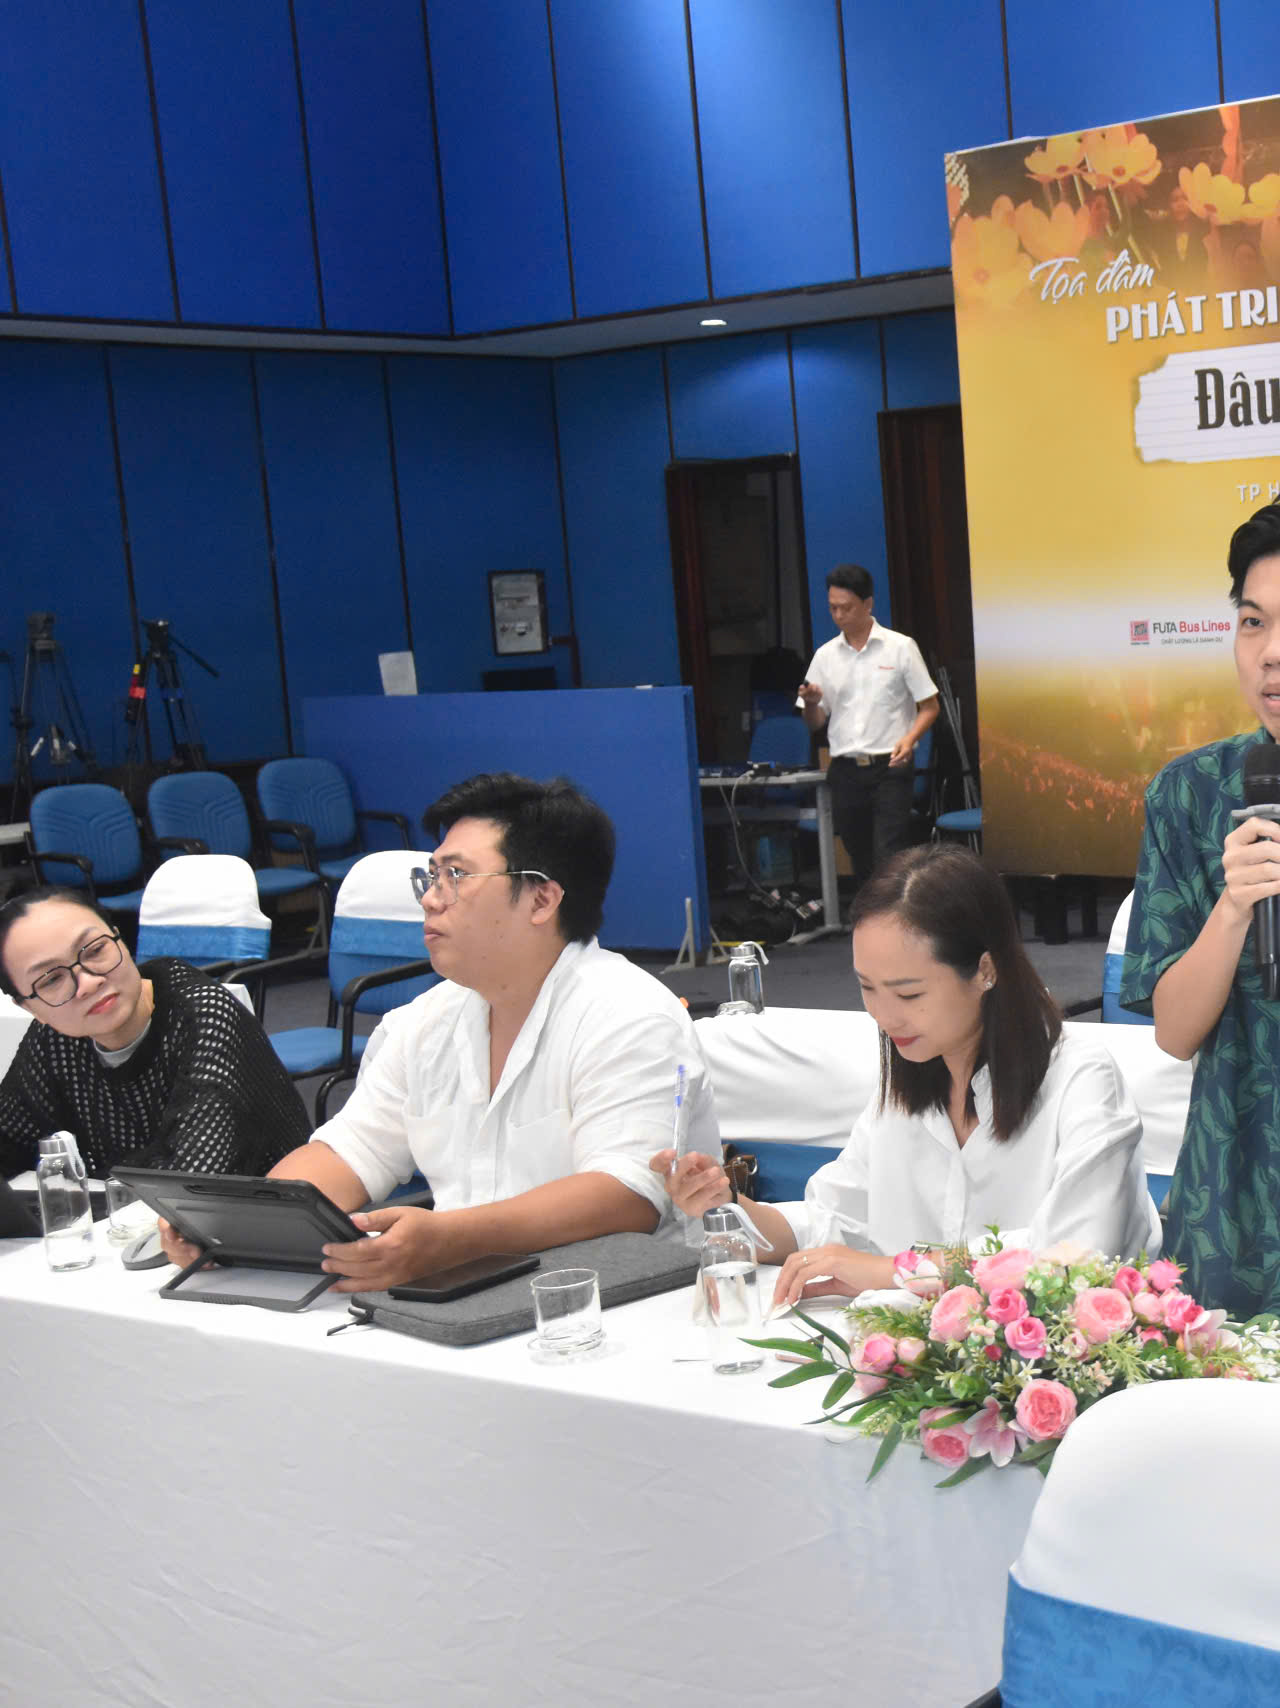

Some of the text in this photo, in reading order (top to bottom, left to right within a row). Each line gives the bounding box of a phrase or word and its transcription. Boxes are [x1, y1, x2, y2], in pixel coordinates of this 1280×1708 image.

[1029, 256, 1088, 304] Tọa
[1106, 291, 1207, 343] PHÁT
[1237, 484, 1260, 503] TP
[1152, 620, 1231, 634] FUTA Bus Lines
